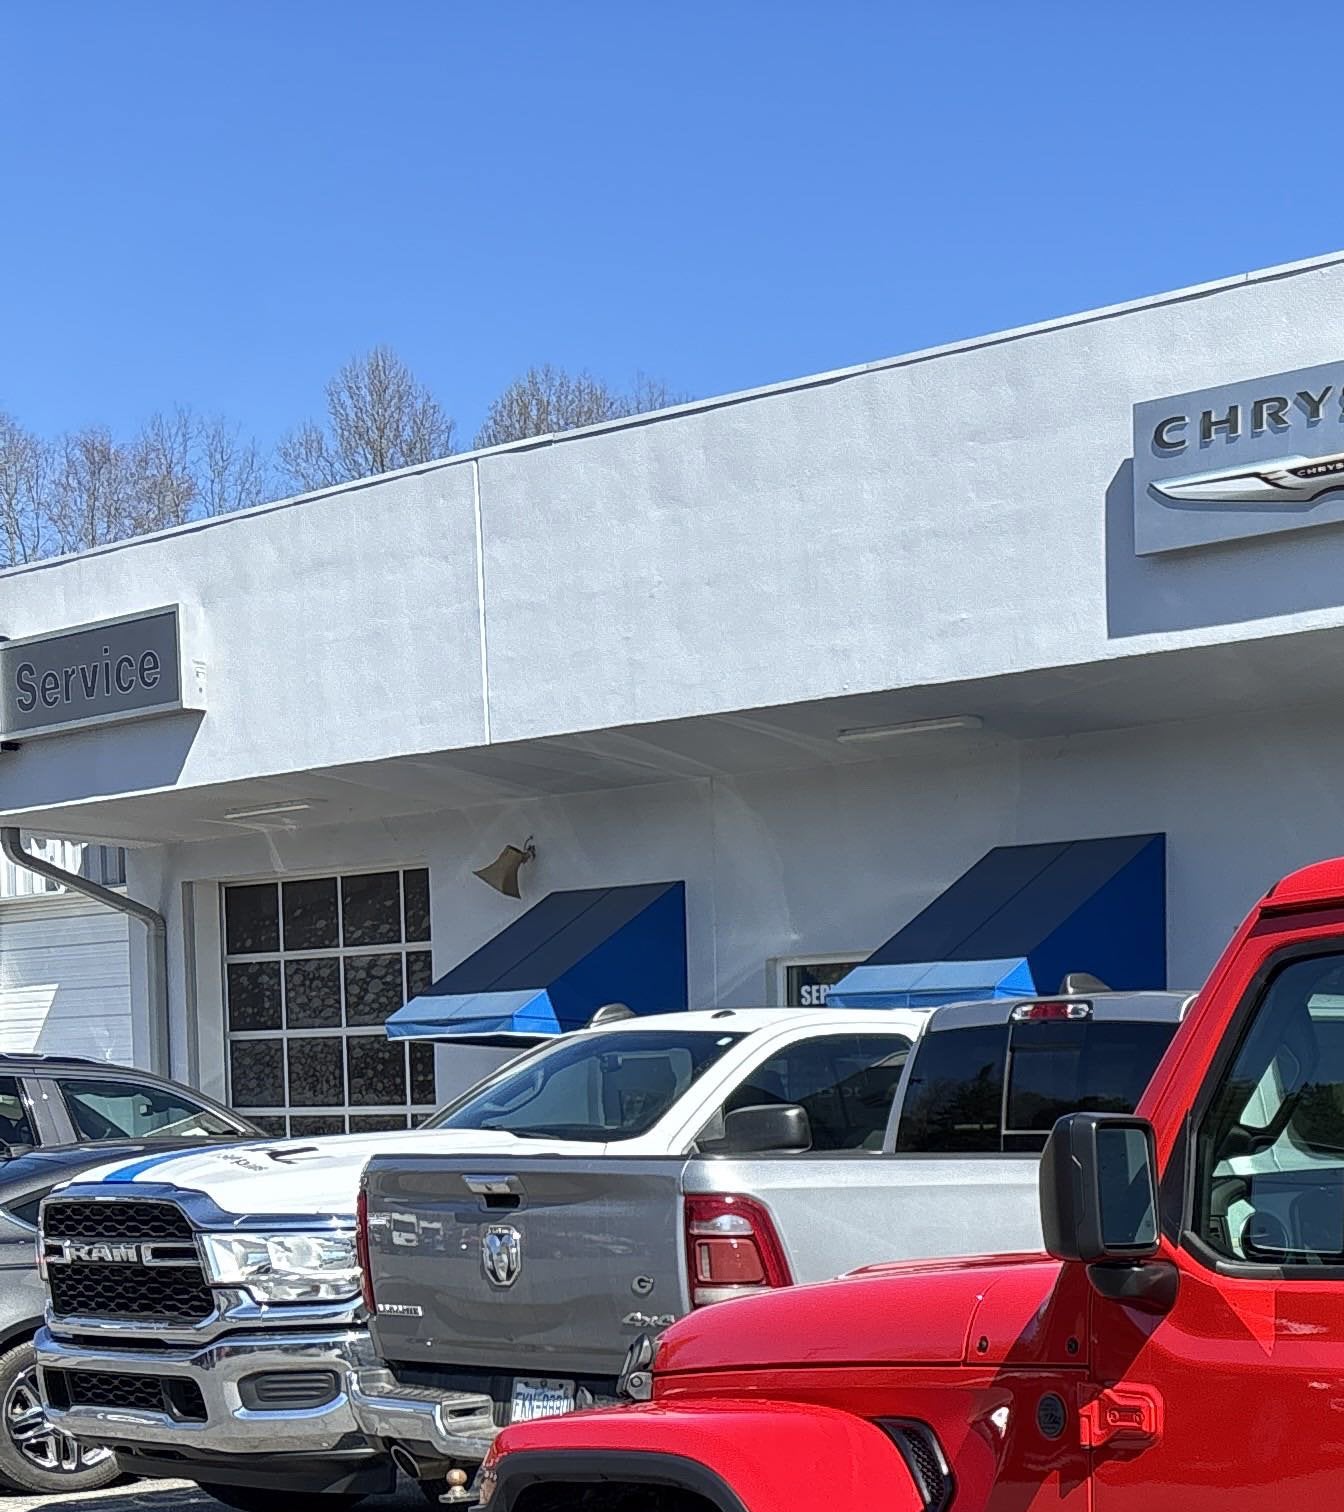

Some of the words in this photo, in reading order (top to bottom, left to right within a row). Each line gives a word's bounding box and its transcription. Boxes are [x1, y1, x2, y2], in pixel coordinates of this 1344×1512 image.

[16, 646, 161, 712] Service
[800, 983, 836, 1006] SER
[69, 1243, 139, 1262] RAM
